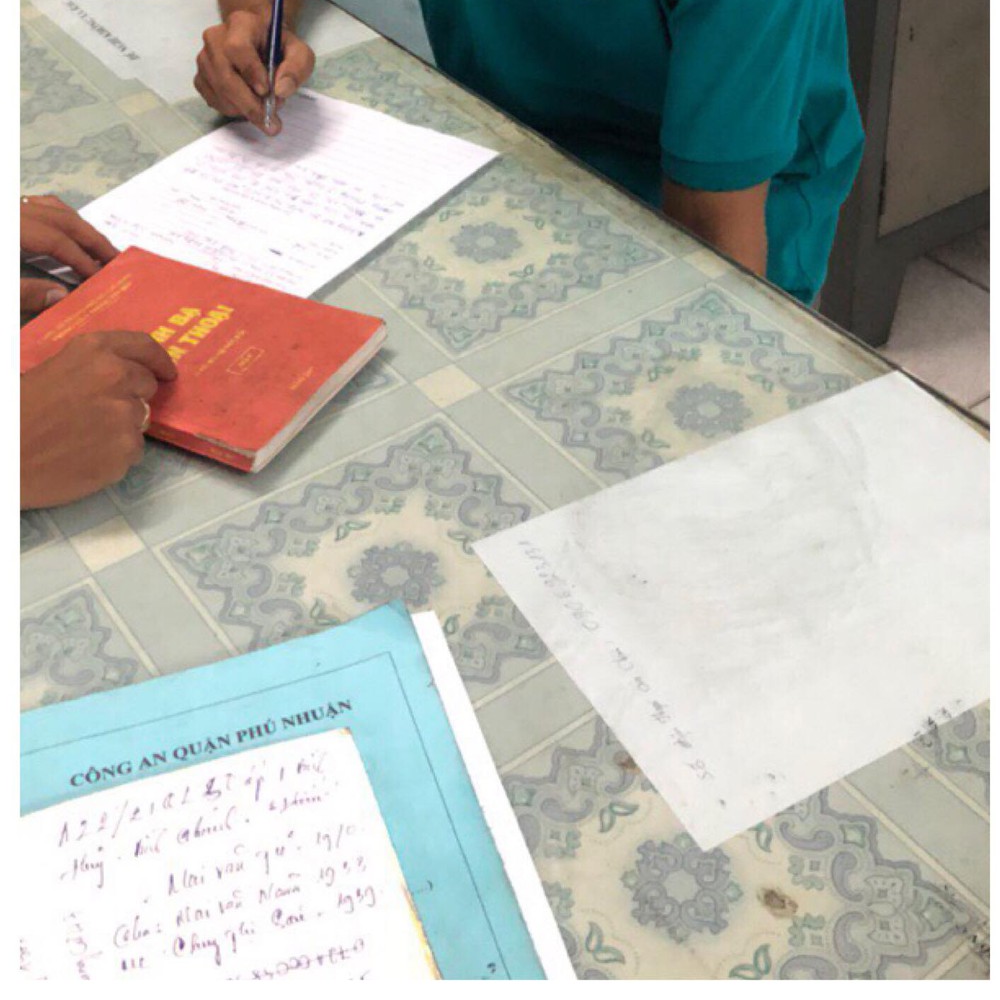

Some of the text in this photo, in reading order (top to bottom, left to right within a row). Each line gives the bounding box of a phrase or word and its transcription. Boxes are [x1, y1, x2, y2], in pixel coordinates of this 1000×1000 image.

[178, 304, 235, 345] THOẠI
[70, 699, 353, 788] CÔNG AN QUẬN PHÚ NHUẬN
